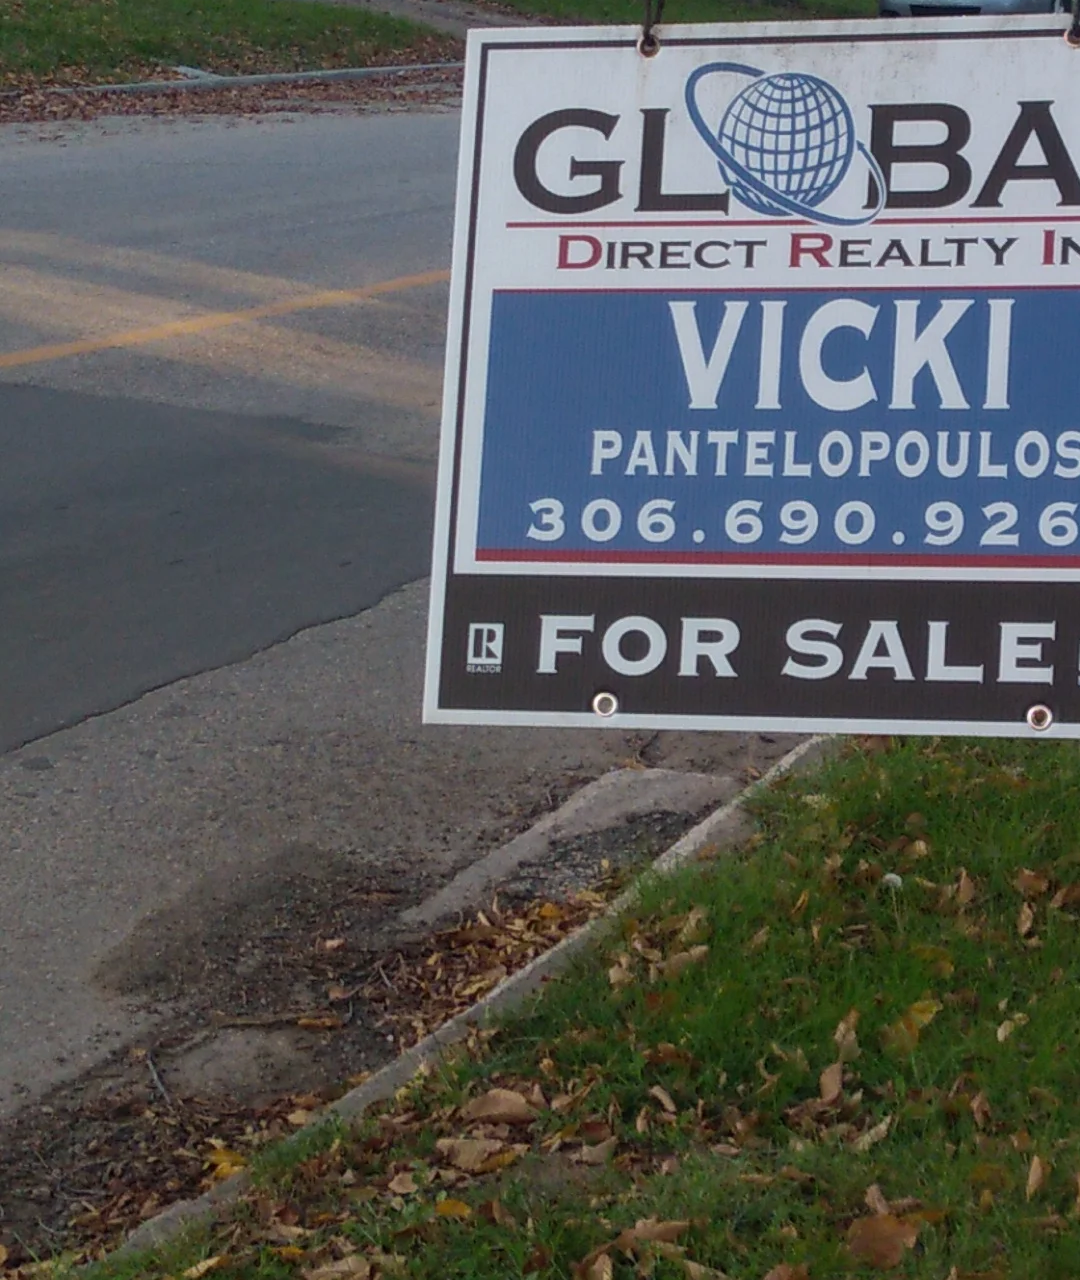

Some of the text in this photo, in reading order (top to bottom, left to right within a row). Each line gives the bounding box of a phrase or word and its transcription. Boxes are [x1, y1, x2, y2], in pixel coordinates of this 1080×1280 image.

[557, 235, 768, 270] DIRECT
[790, 234, 1018, 269] REALTY
[669, 299, 1016, 411] VICKI
[536, 614, 1057, 684] FOR SALE
